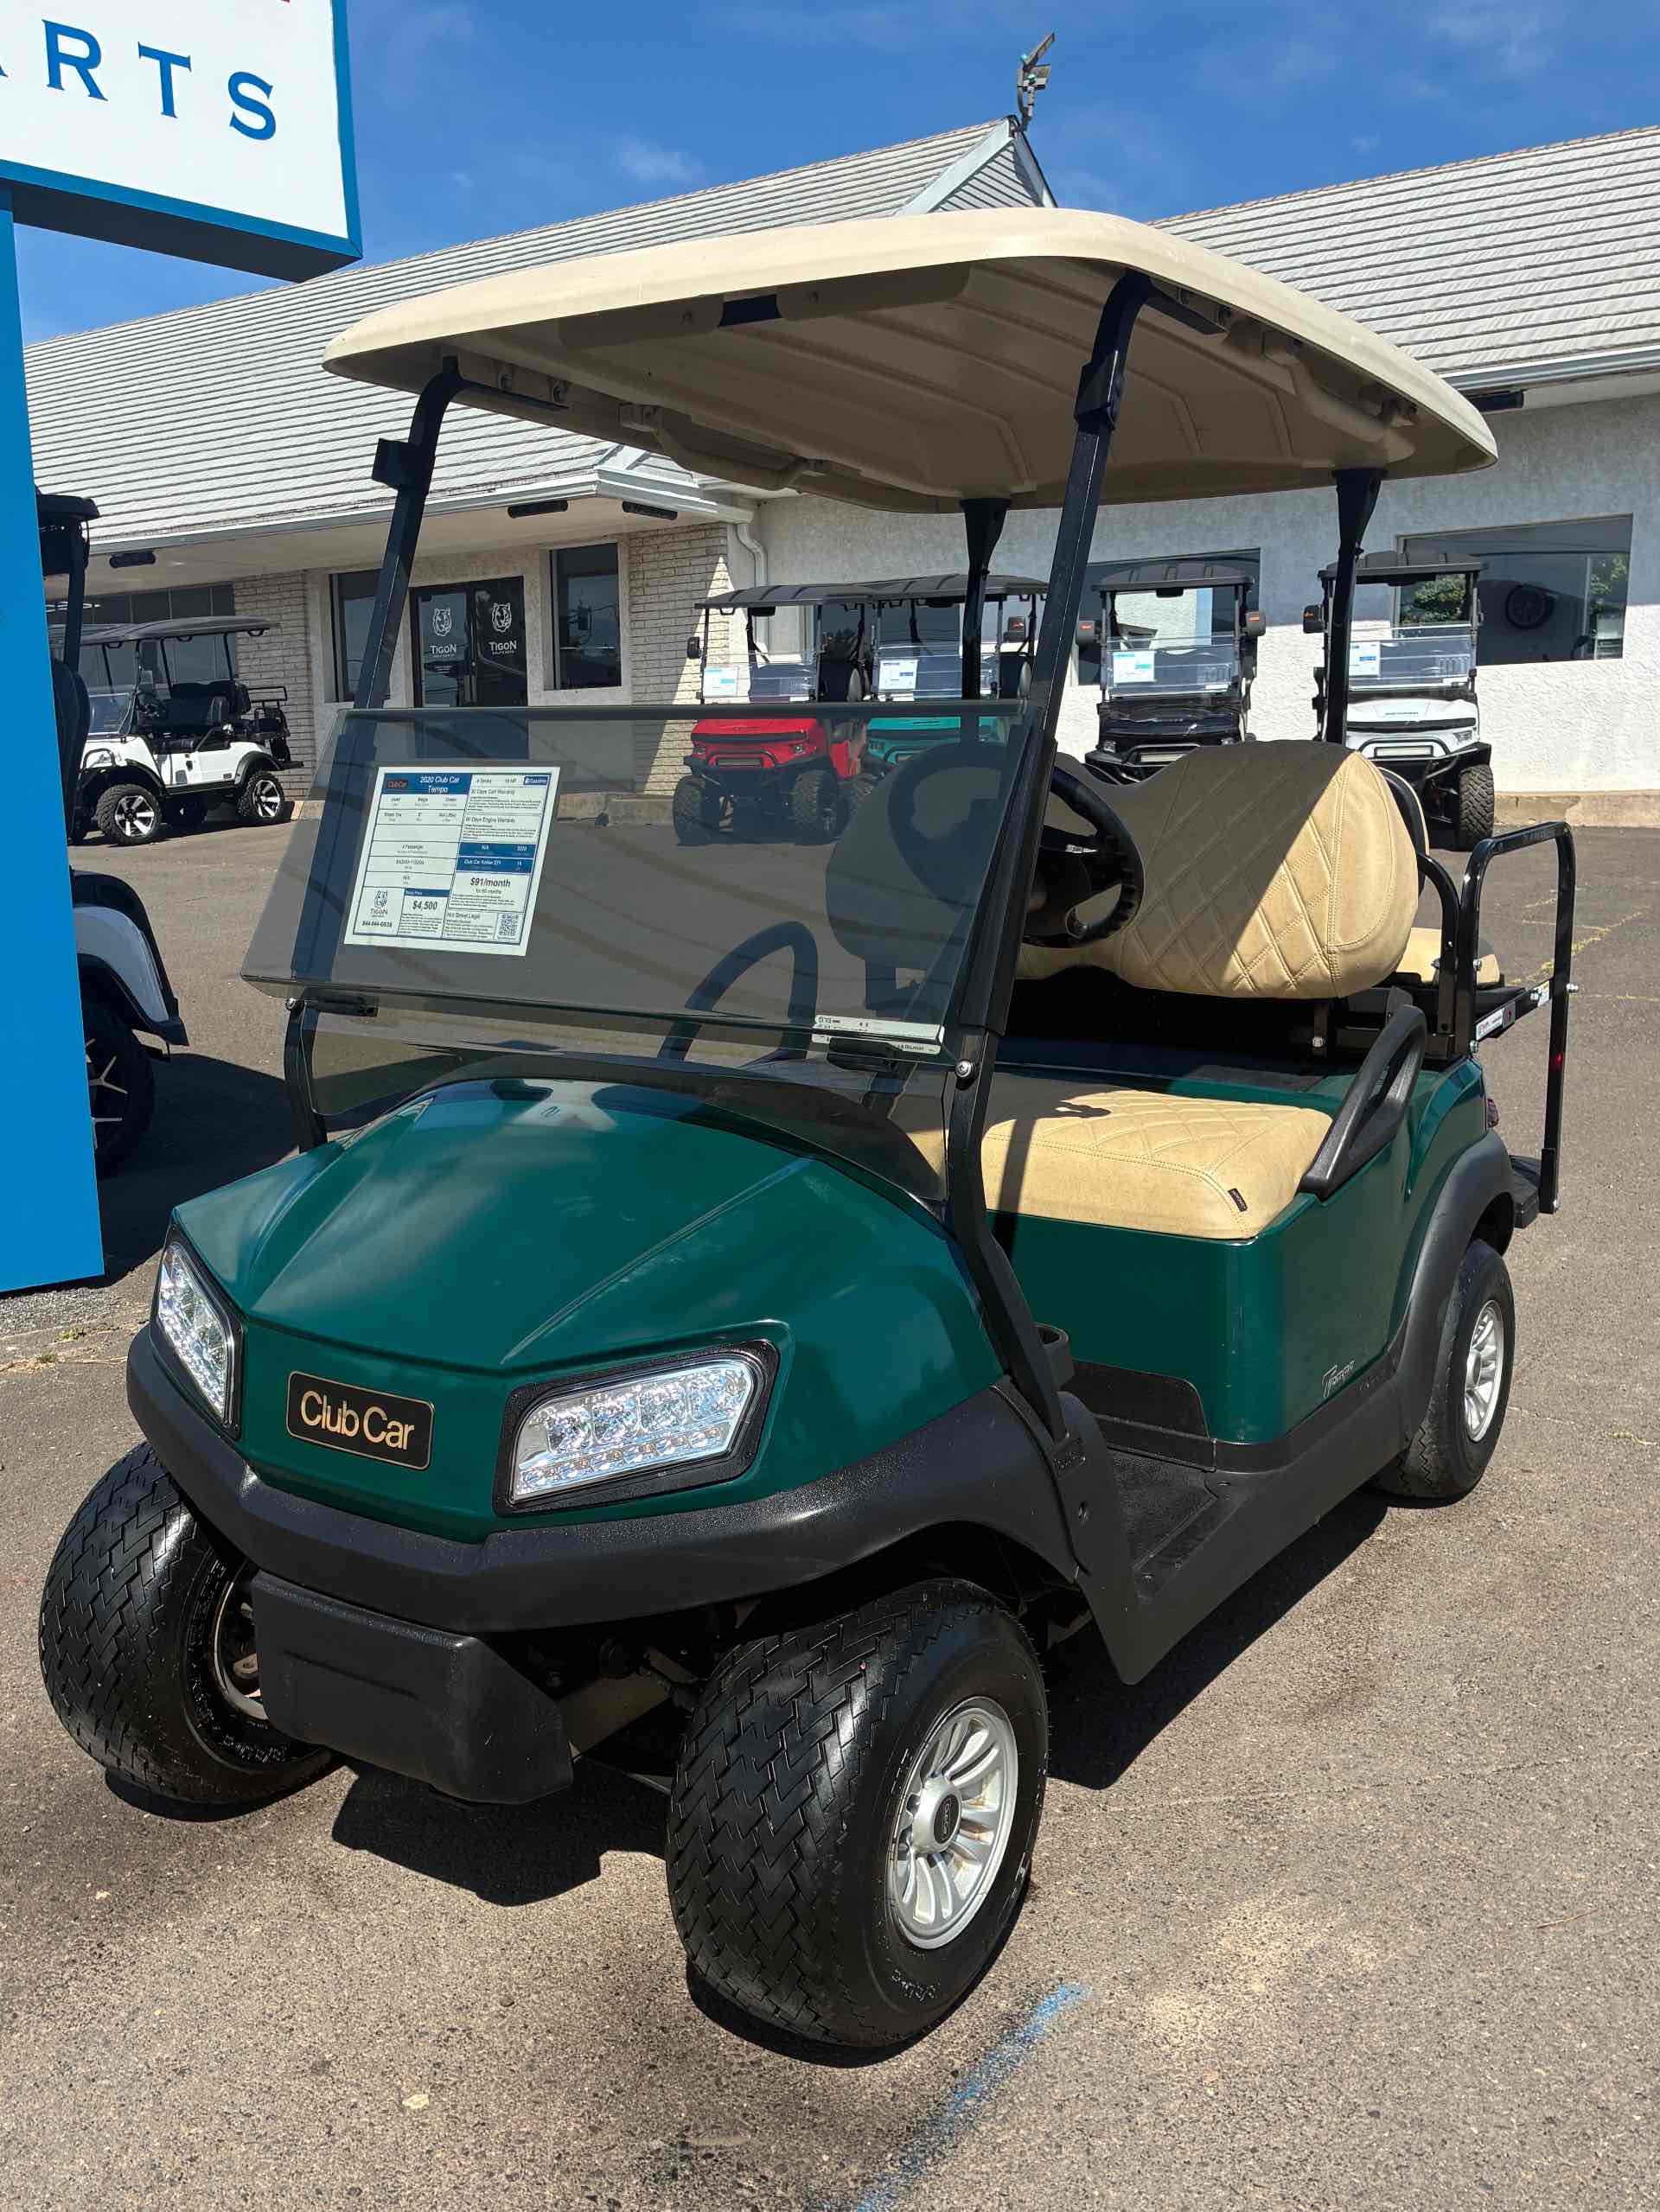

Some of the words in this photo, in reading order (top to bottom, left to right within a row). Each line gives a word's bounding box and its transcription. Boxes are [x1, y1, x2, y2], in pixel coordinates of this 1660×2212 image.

[0, 19, 277, 141] RTS
[430, 644, 457, 654] TIGON
[488, 641, 517, 651] TIGON
[469, 877, 511, 888] $91/month
[412, 900, 438, 911] $4,500
[300, 1390, 361, 1438] Club
[362, 1405, 415, 1450] Car
